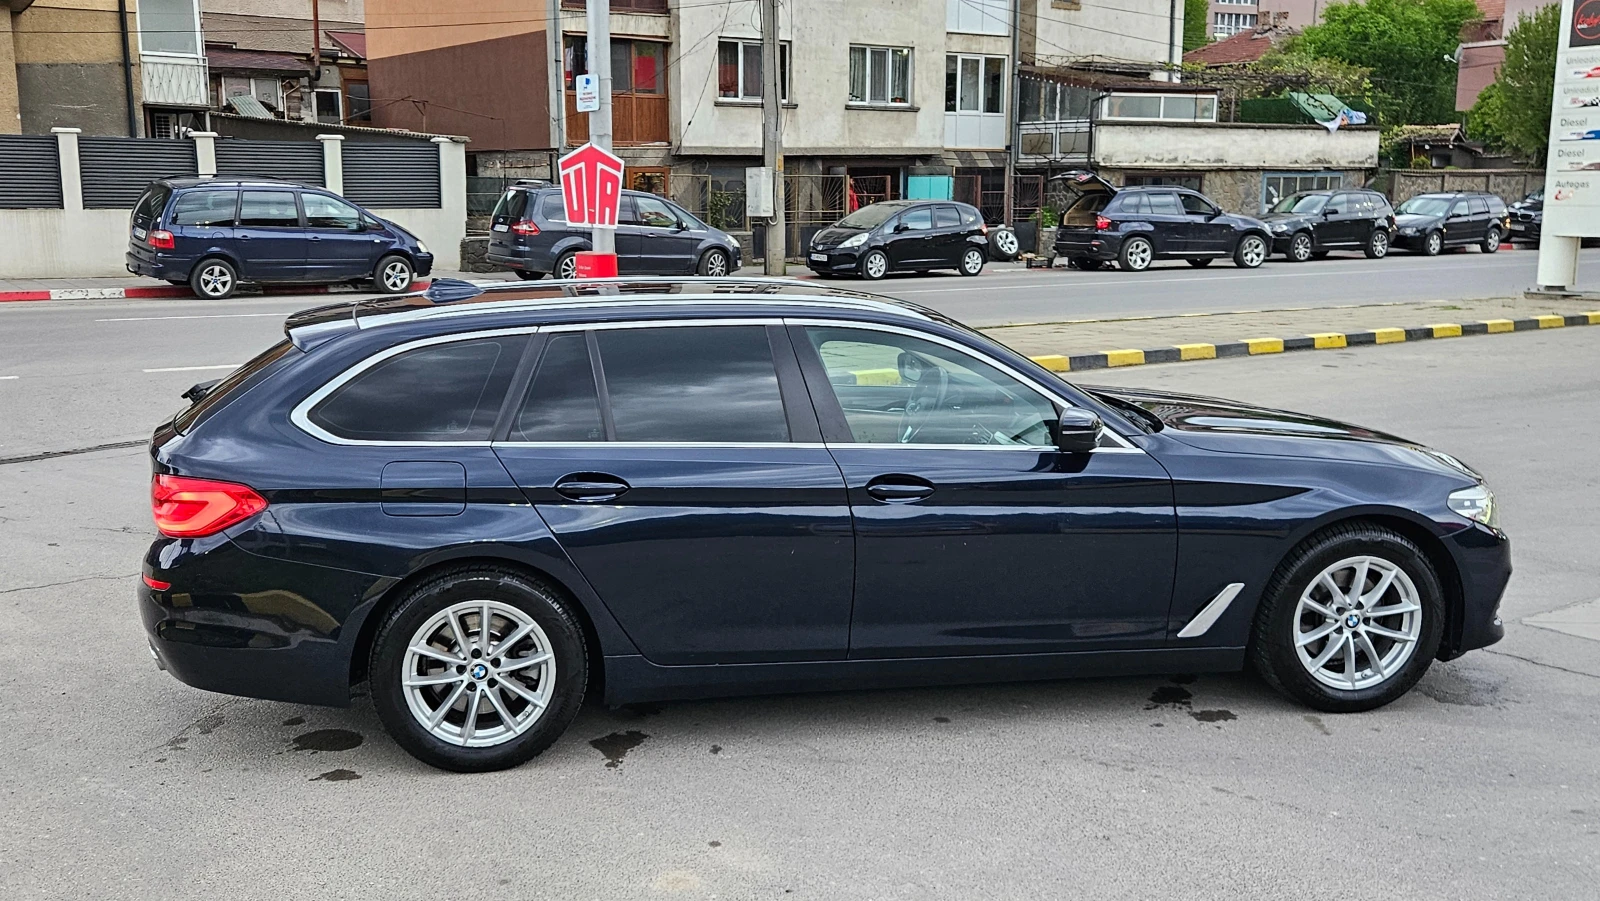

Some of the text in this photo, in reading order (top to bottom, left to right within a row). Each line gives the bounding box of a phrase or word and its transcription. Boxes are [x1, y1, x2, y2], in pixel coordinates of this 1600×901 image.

[1560, 117, 1588, 127] Diesel
[1557, 148, 1585, 158] Diesel
[560, 145, 622, 226] UTA
